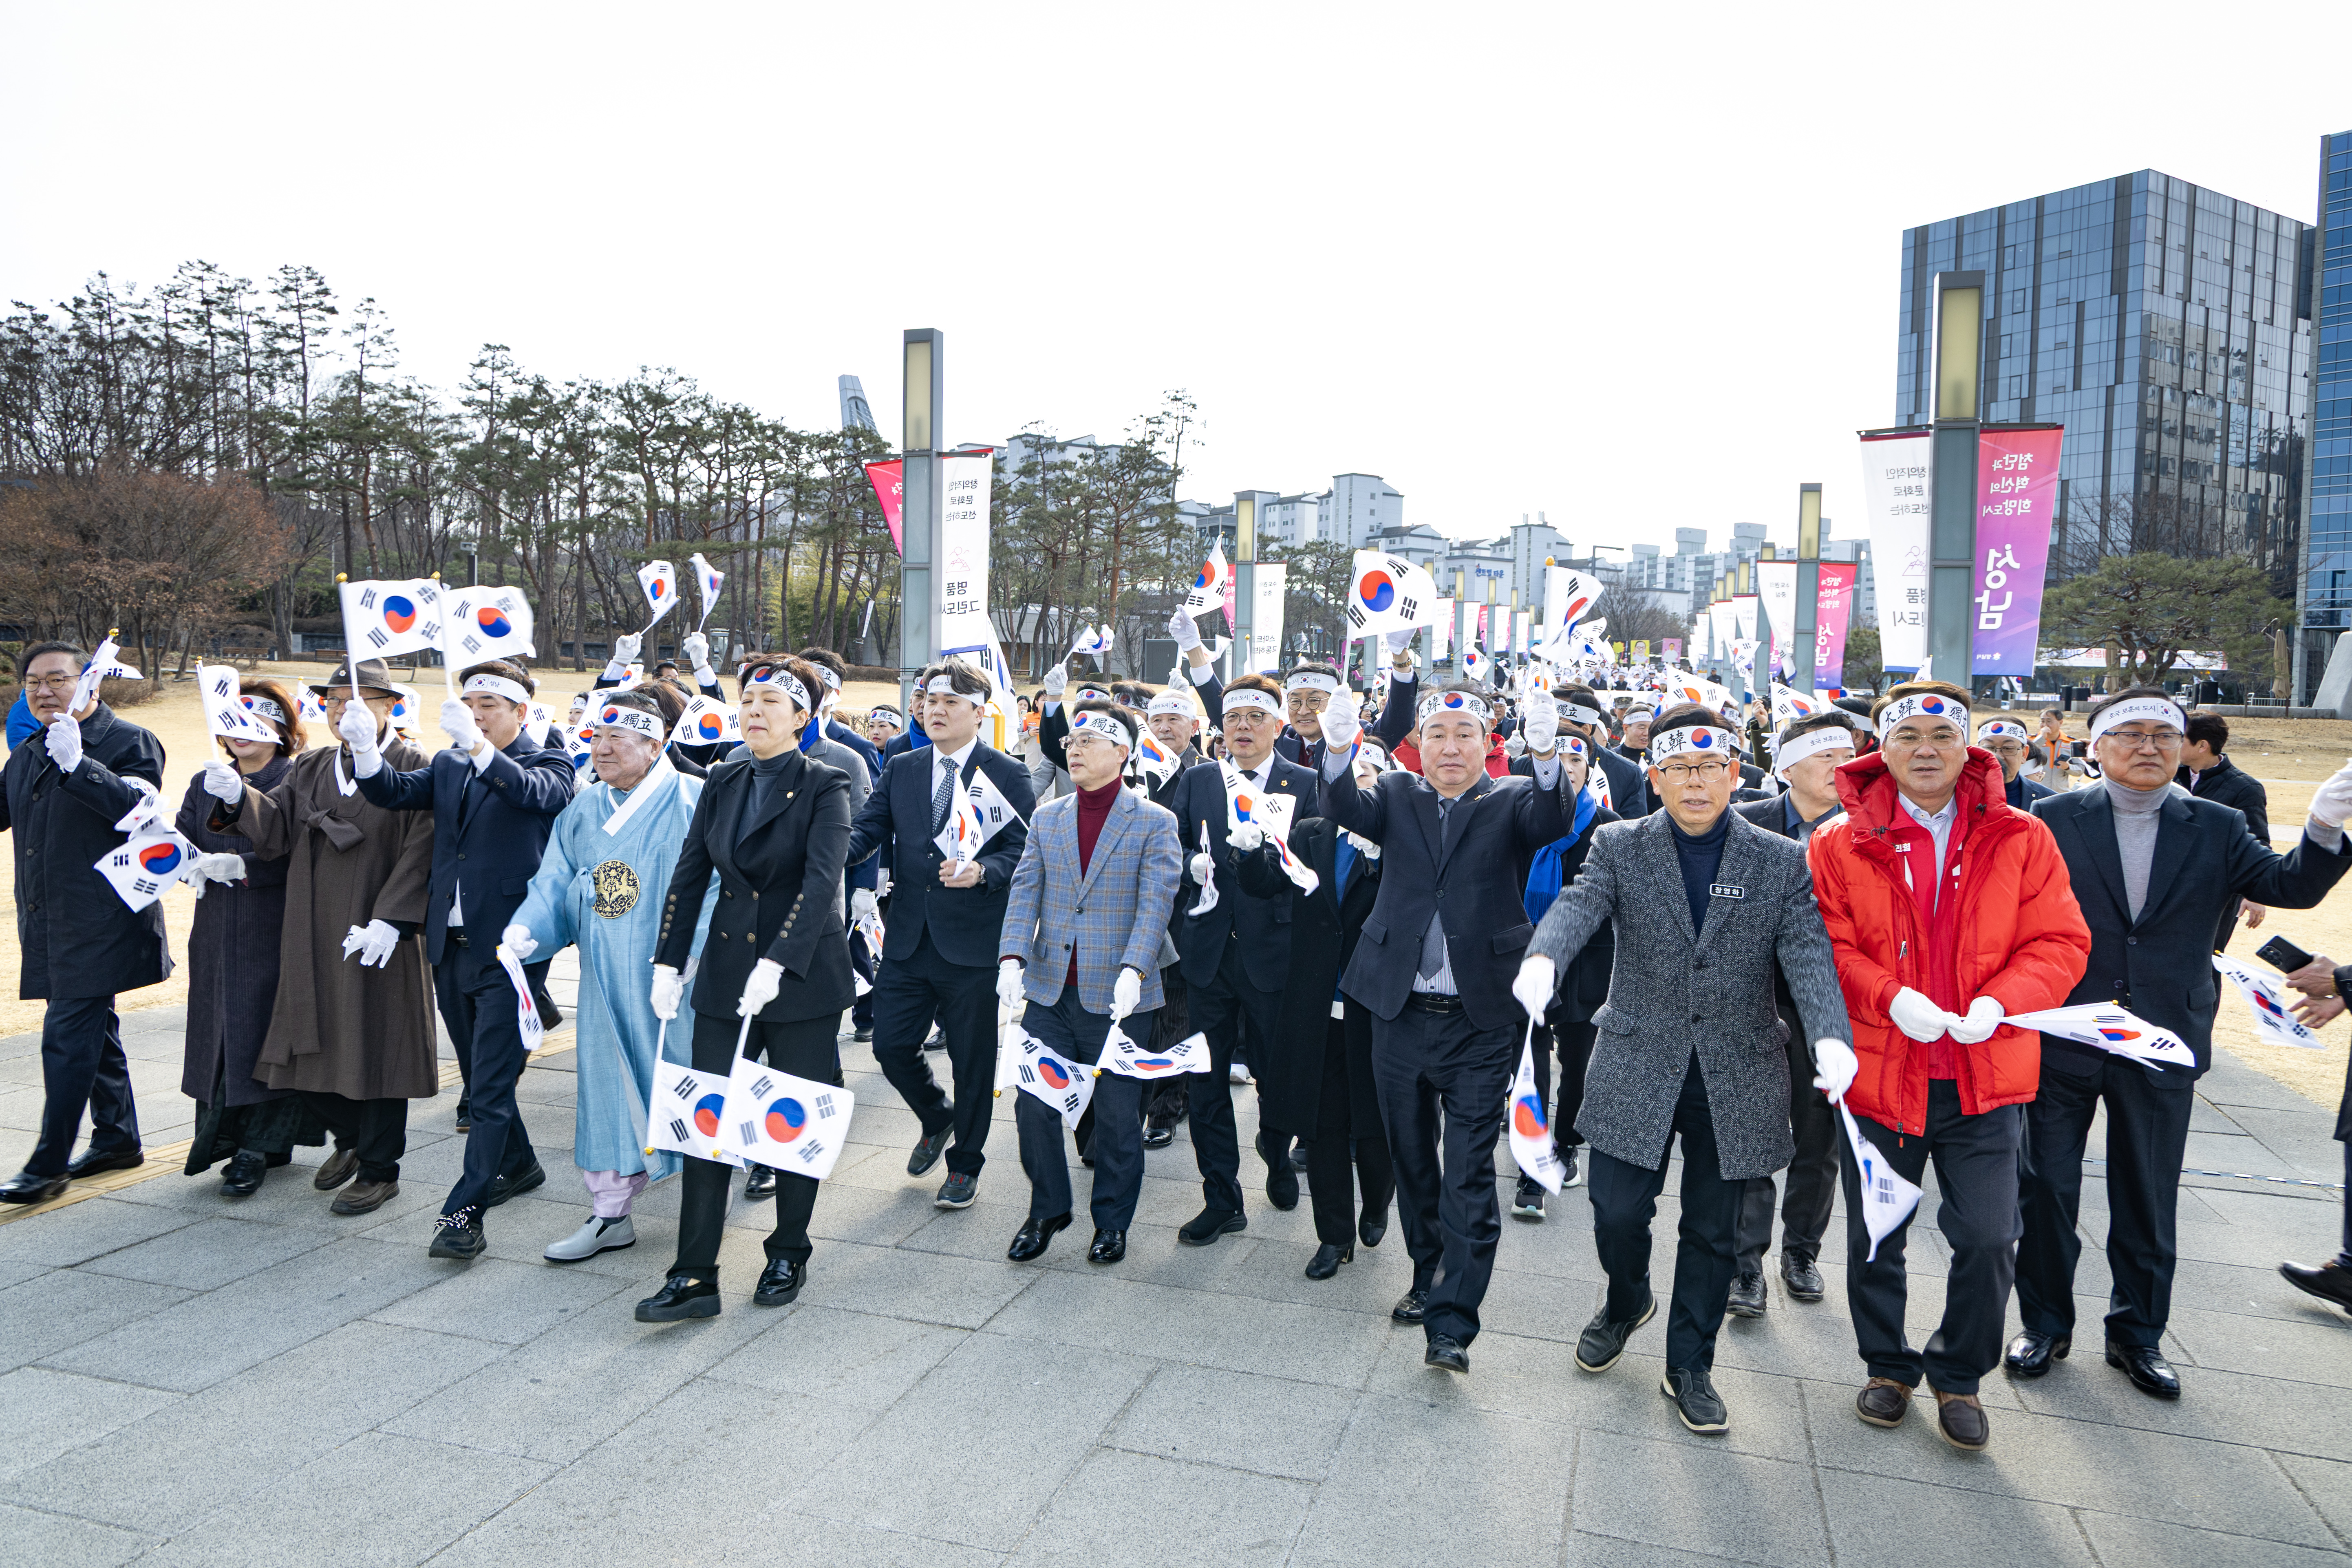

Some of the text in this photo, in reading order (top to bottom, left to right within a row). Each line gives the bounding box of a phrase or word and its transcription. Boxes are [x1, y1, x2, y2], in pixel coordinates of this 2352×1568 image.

[1494, 569, 1505, 578] 타운
[775, 675, 805, 699] 獨立
[257, 701, 282, 718] 獨立
[878, 712, 893, 721] 獨立
[1556, 704, 1578, 718] 獨立
[1885, 698, 1917, 729] 大韓
[2109, 710, 2121, 719] 호국
[2122, 706, 2140, 715] 보훈의
[621, 713, 652, 732] 獨立
[1090, 718, 1118, 737] 獨立
[2006, 726, 2025, 740] 獨立
[1555, 737, 1567, 751] 韓
[1657, 730, 1687, 757] 大韓
[1717, 733, 1730, 752] 獨
[1810, 738, 1821, 746] 호국
[1375, 752, 1381, 761] 성남
